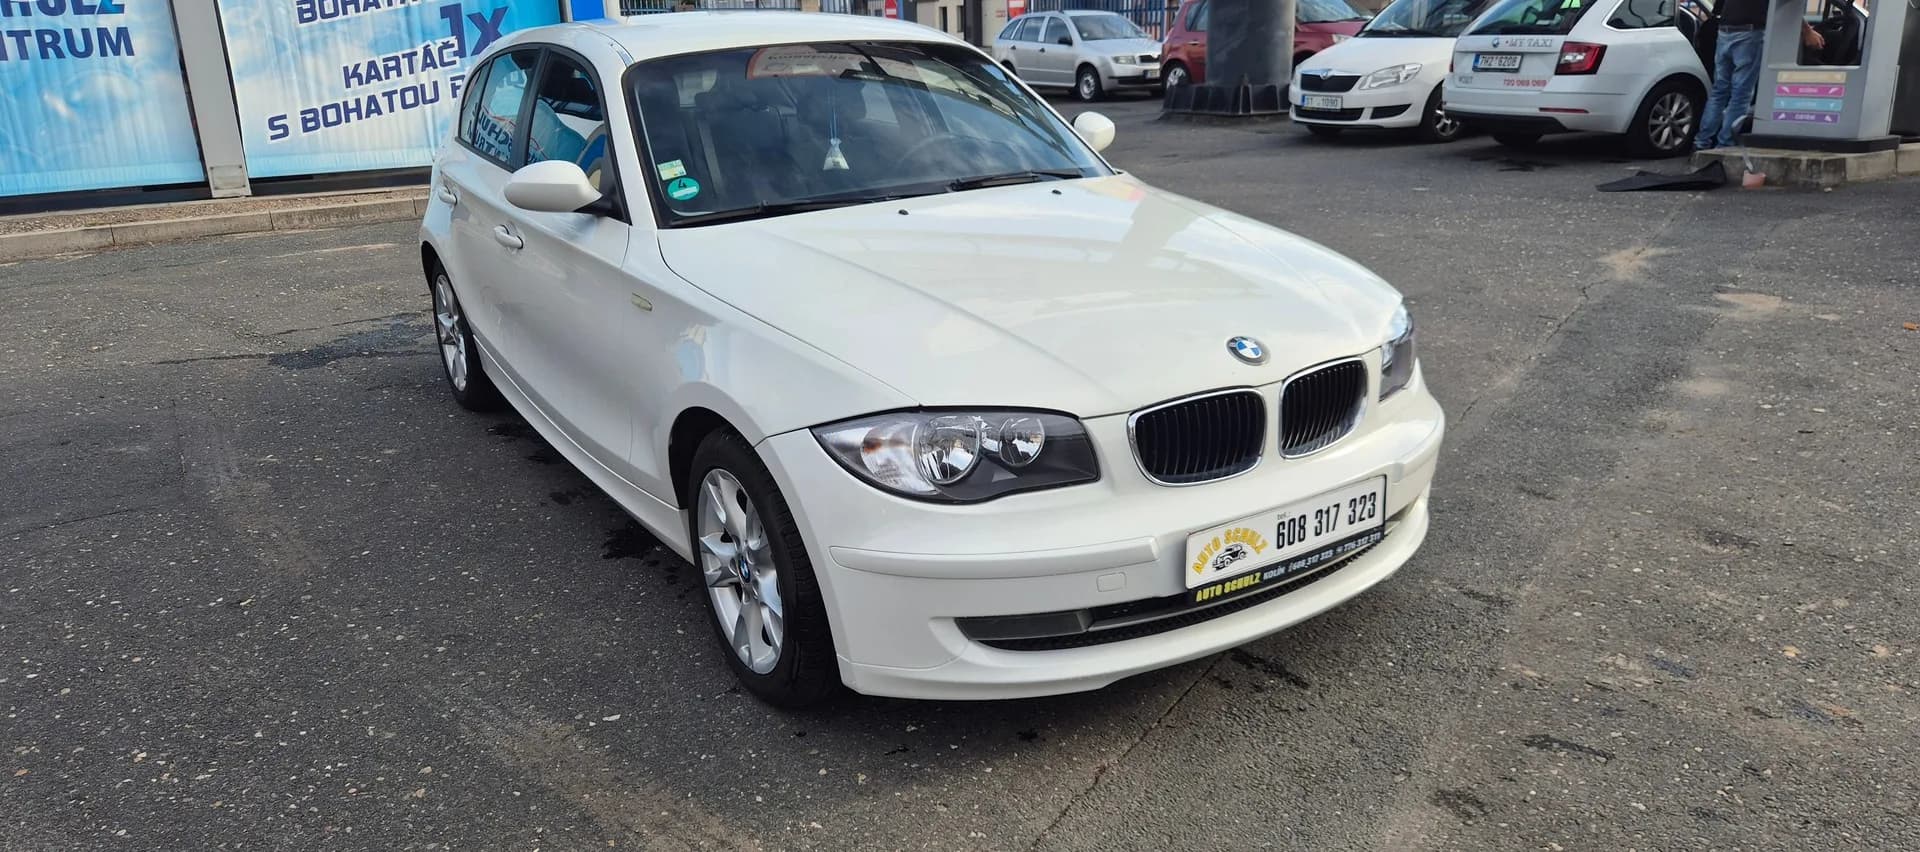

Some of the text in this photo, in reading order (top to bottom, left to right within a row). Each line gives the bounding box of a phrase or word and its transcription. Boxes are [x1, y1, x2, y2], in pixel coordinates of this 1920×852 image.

[343, 40, 458, 89] KARTÁČ
[1527, 39, 1553, 47] TAXI
[268, 114, 290, 141] S
[300, 81, 440, 133] BOHATOU
[678, 179, 687, 188] 4
[1277, 491, 1377, 550] 608 317 323
[1192, 527, 1269, 575] AUTO SCHULZ
[1196, 584, 1223, 602] AUTO
[1224, 572, 1262, 593] SCHULZ
